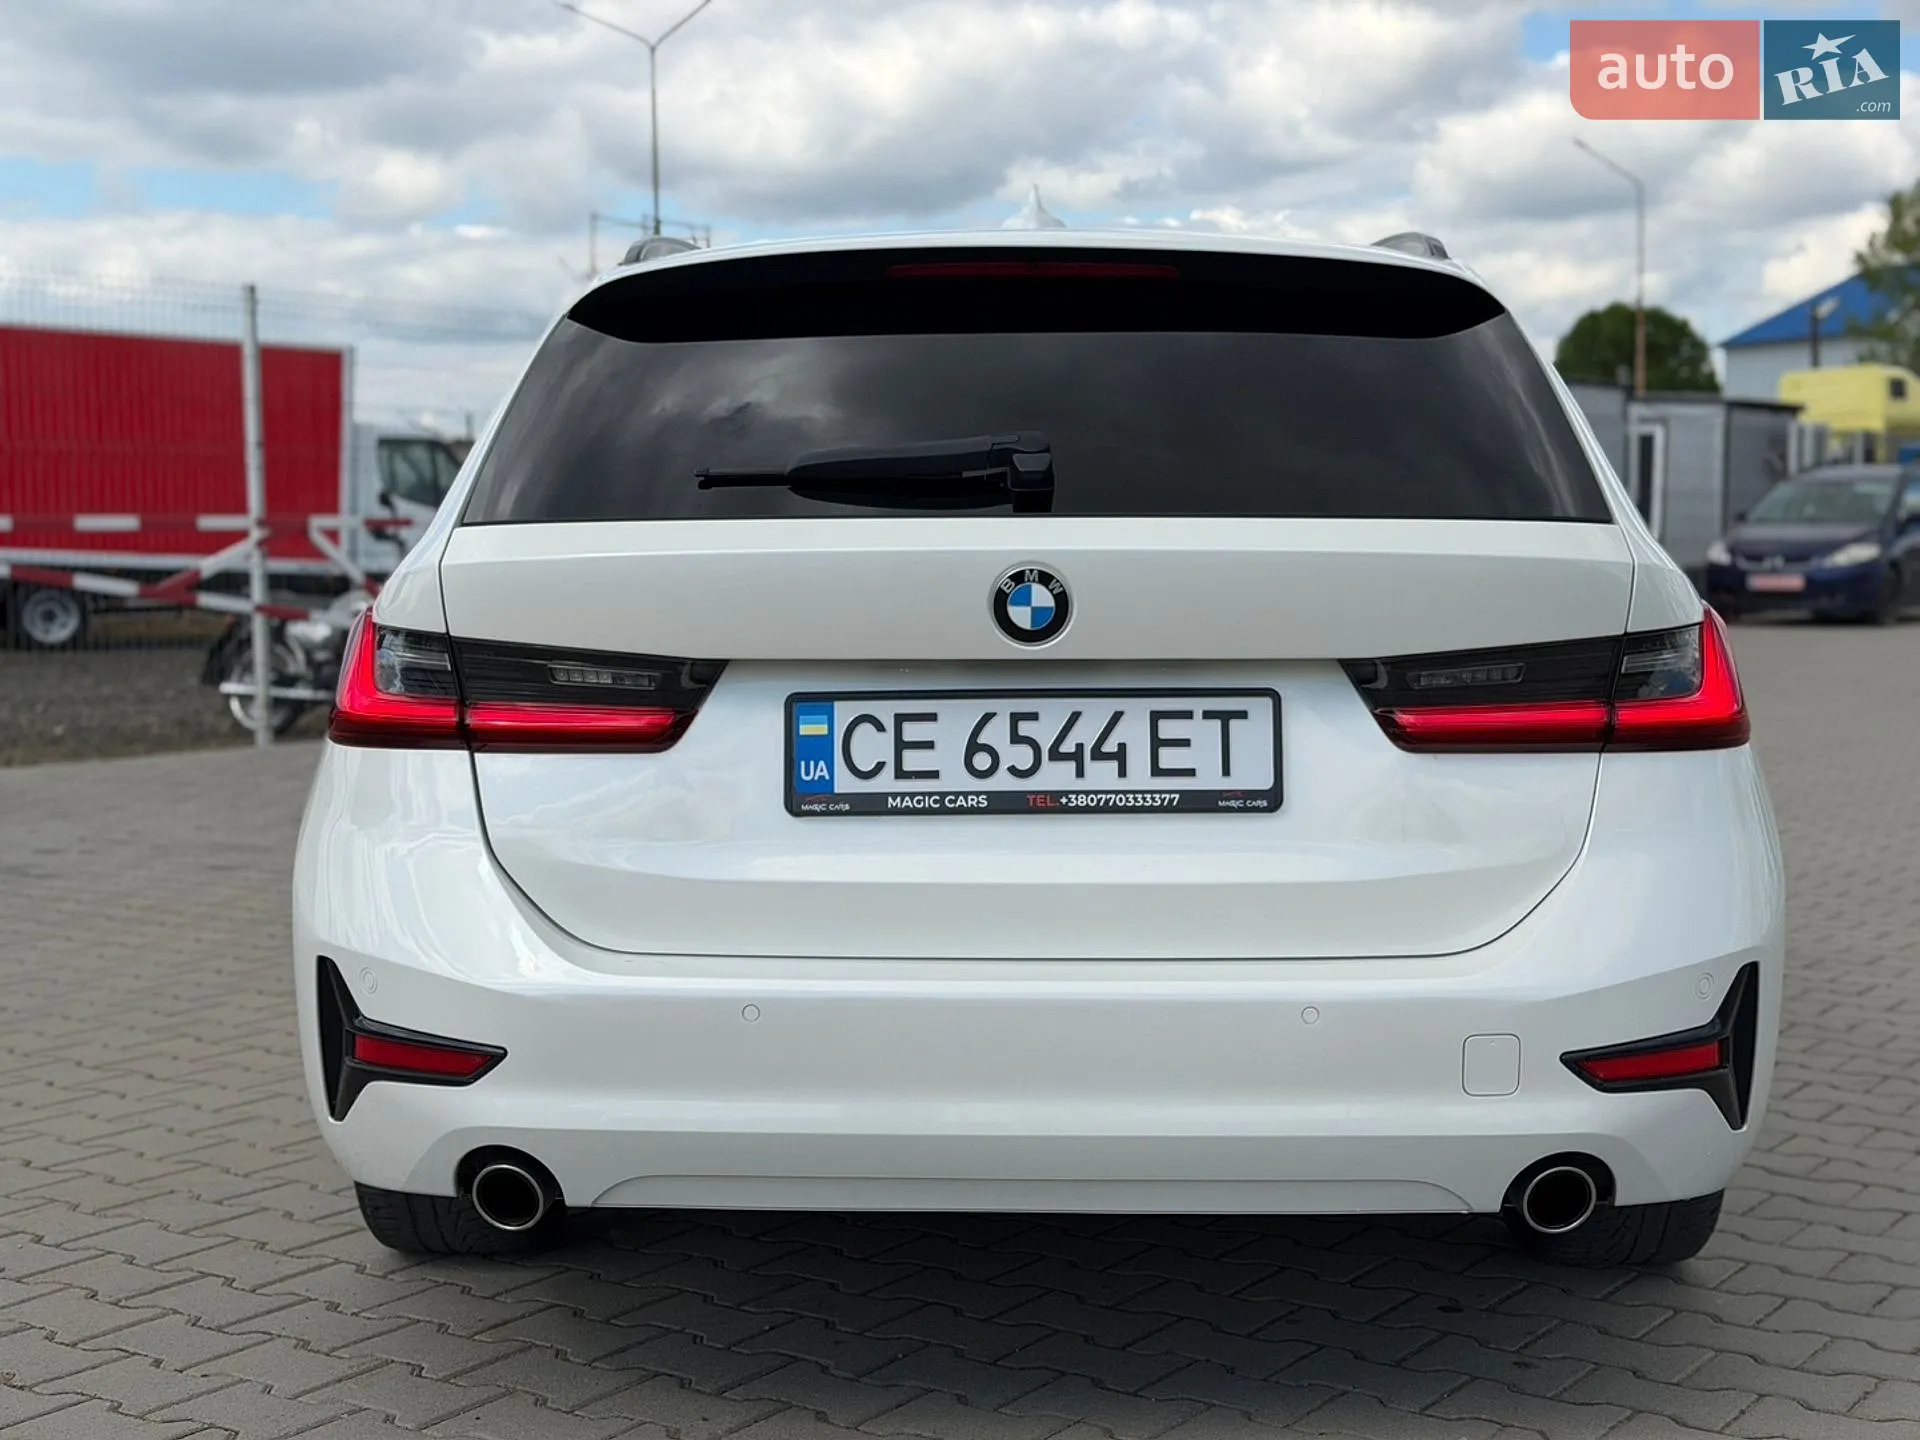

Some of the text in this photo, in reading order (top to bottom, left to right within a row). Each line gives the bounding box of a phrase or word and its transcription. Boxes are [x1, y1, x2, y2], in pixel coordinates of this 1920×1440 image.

[1000, 569, 1063, 595] BMW
[841, 709, 1249, 781] CE 6544 ET
[800, 760, 831, 781] UA
[887, 796, 941, 809] MAGIC
[944, 795, 989, 808] CARS
